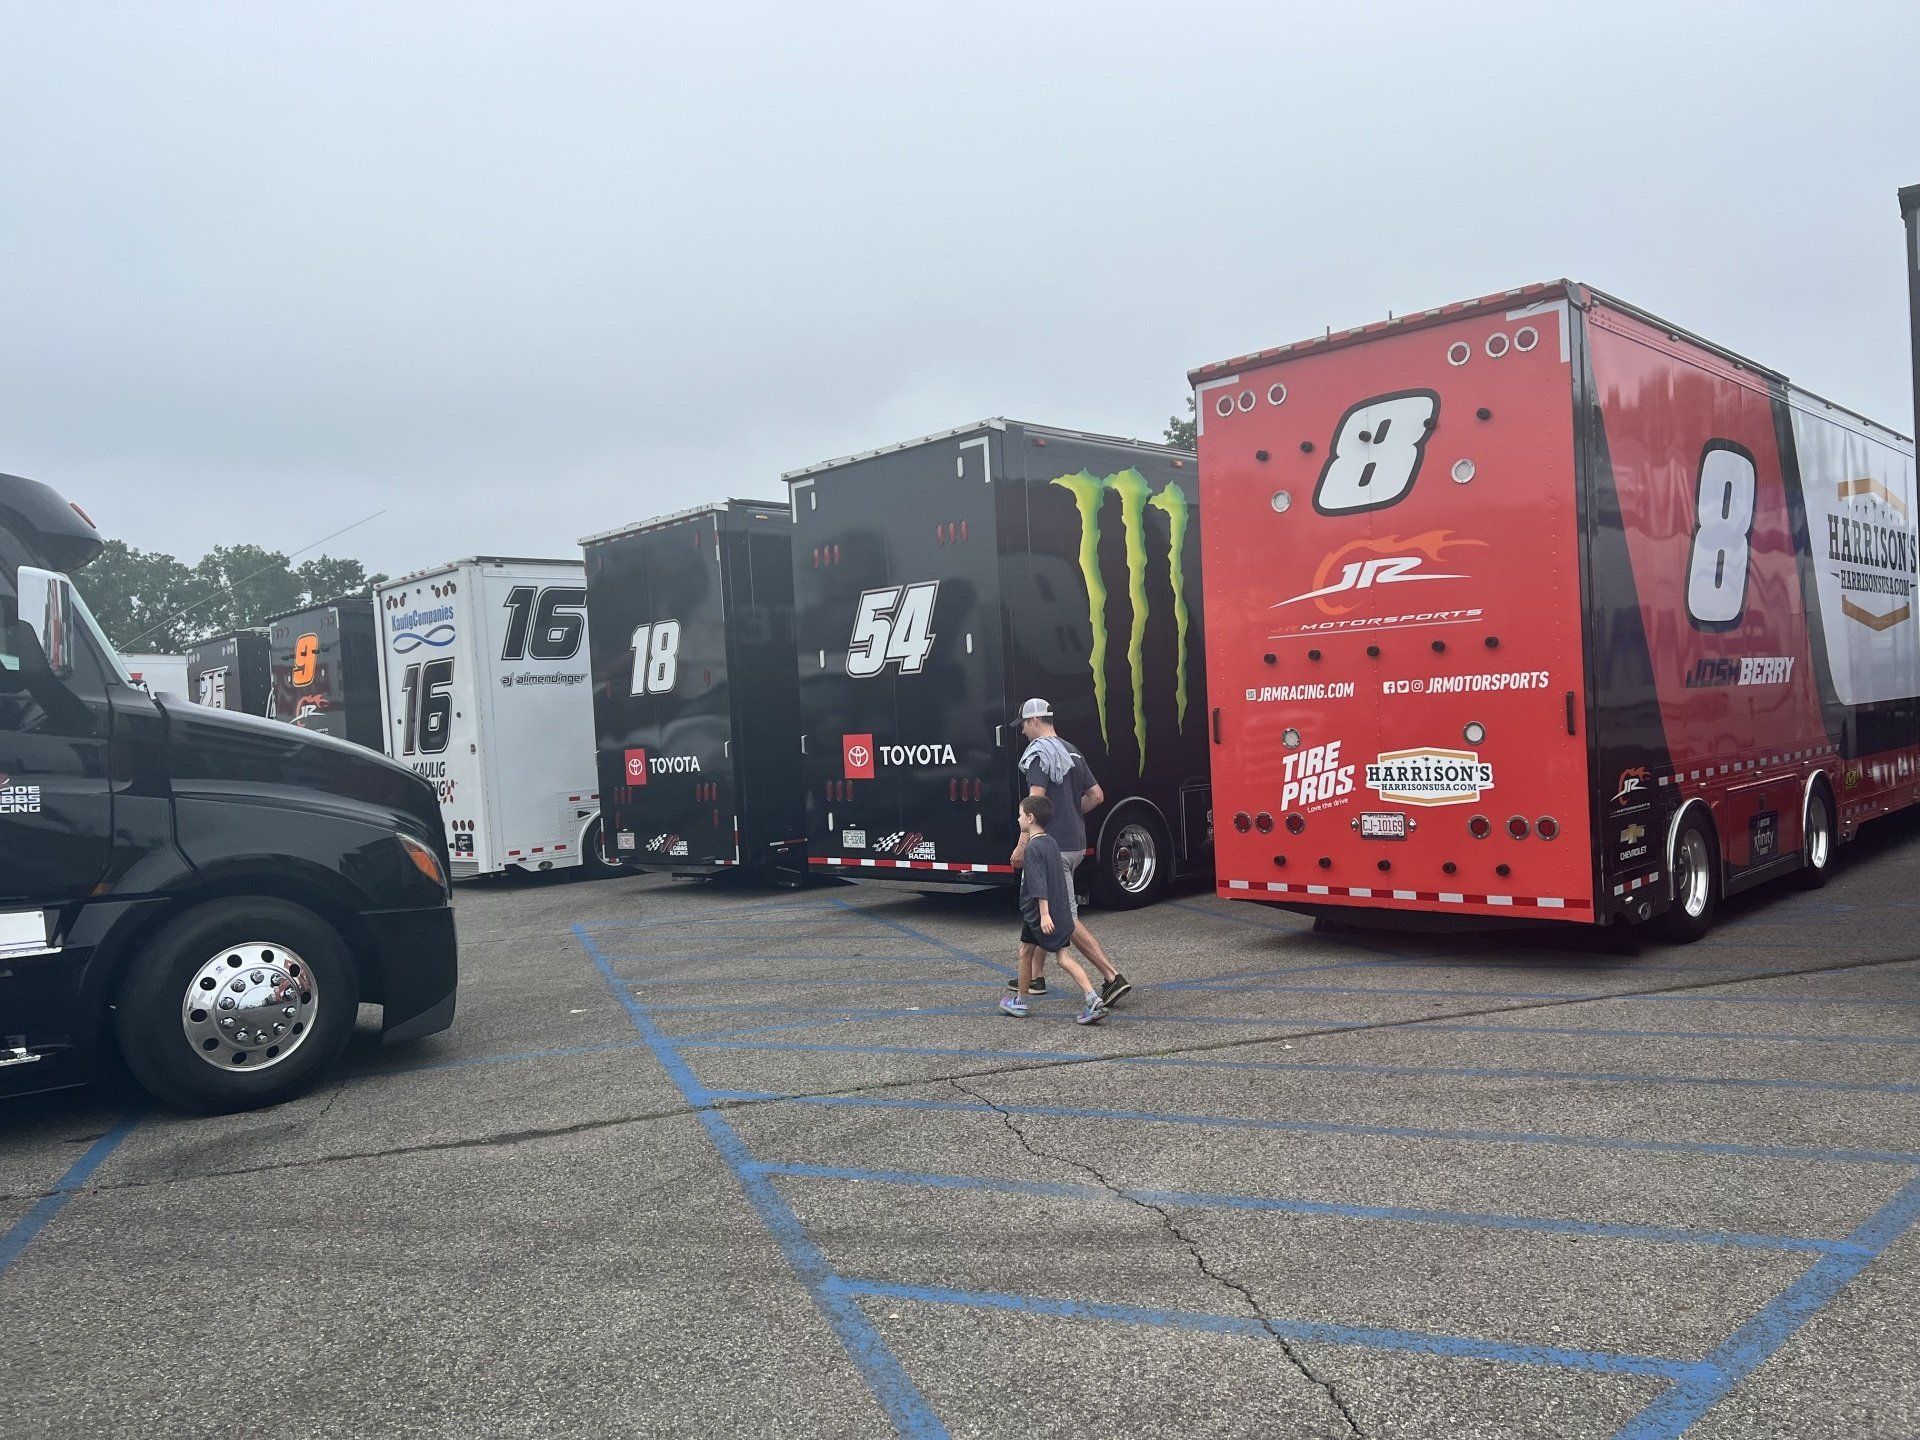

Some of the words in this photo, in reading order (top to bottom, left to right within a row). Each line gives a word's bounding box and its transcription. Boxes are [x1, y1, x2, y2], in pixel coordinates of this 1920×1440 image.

[1312, 388, 1441, 517] 8
[1684, 438, 1757, 633] 8
[1827, 513, 1917, 574] HARRISON'S
[501, 585, 587, 661] 16
[846, 580, 940, 678] 54
[293, 632, 318, 687] 9
[630, 618, 682, 697] 18
[1258, 682, 1355, 702] JRMRACING.COM
[1426, 670, 1549, 694] JRMOTORSPORTS
[401, 656, 455, 757] 16
[649, 756, 700, 774] TOYOTA
[880, 744, 957, 766] TOYOTA
[1282, 739, 1342, 783] TIRE
[1367, 765, 1491, 782] HARRISON'S
[1380, 783, 1478, 791] HARRISONSUSA.COM
[1307, 804, 1322, 813] Love
[1322, 801, 1333, 810] the
[1333, 797, 1349, 808] drive
[1362, 819, 1403, 832] CJ-10169
[1619, 845, 1648, 861] CHEVROLET
